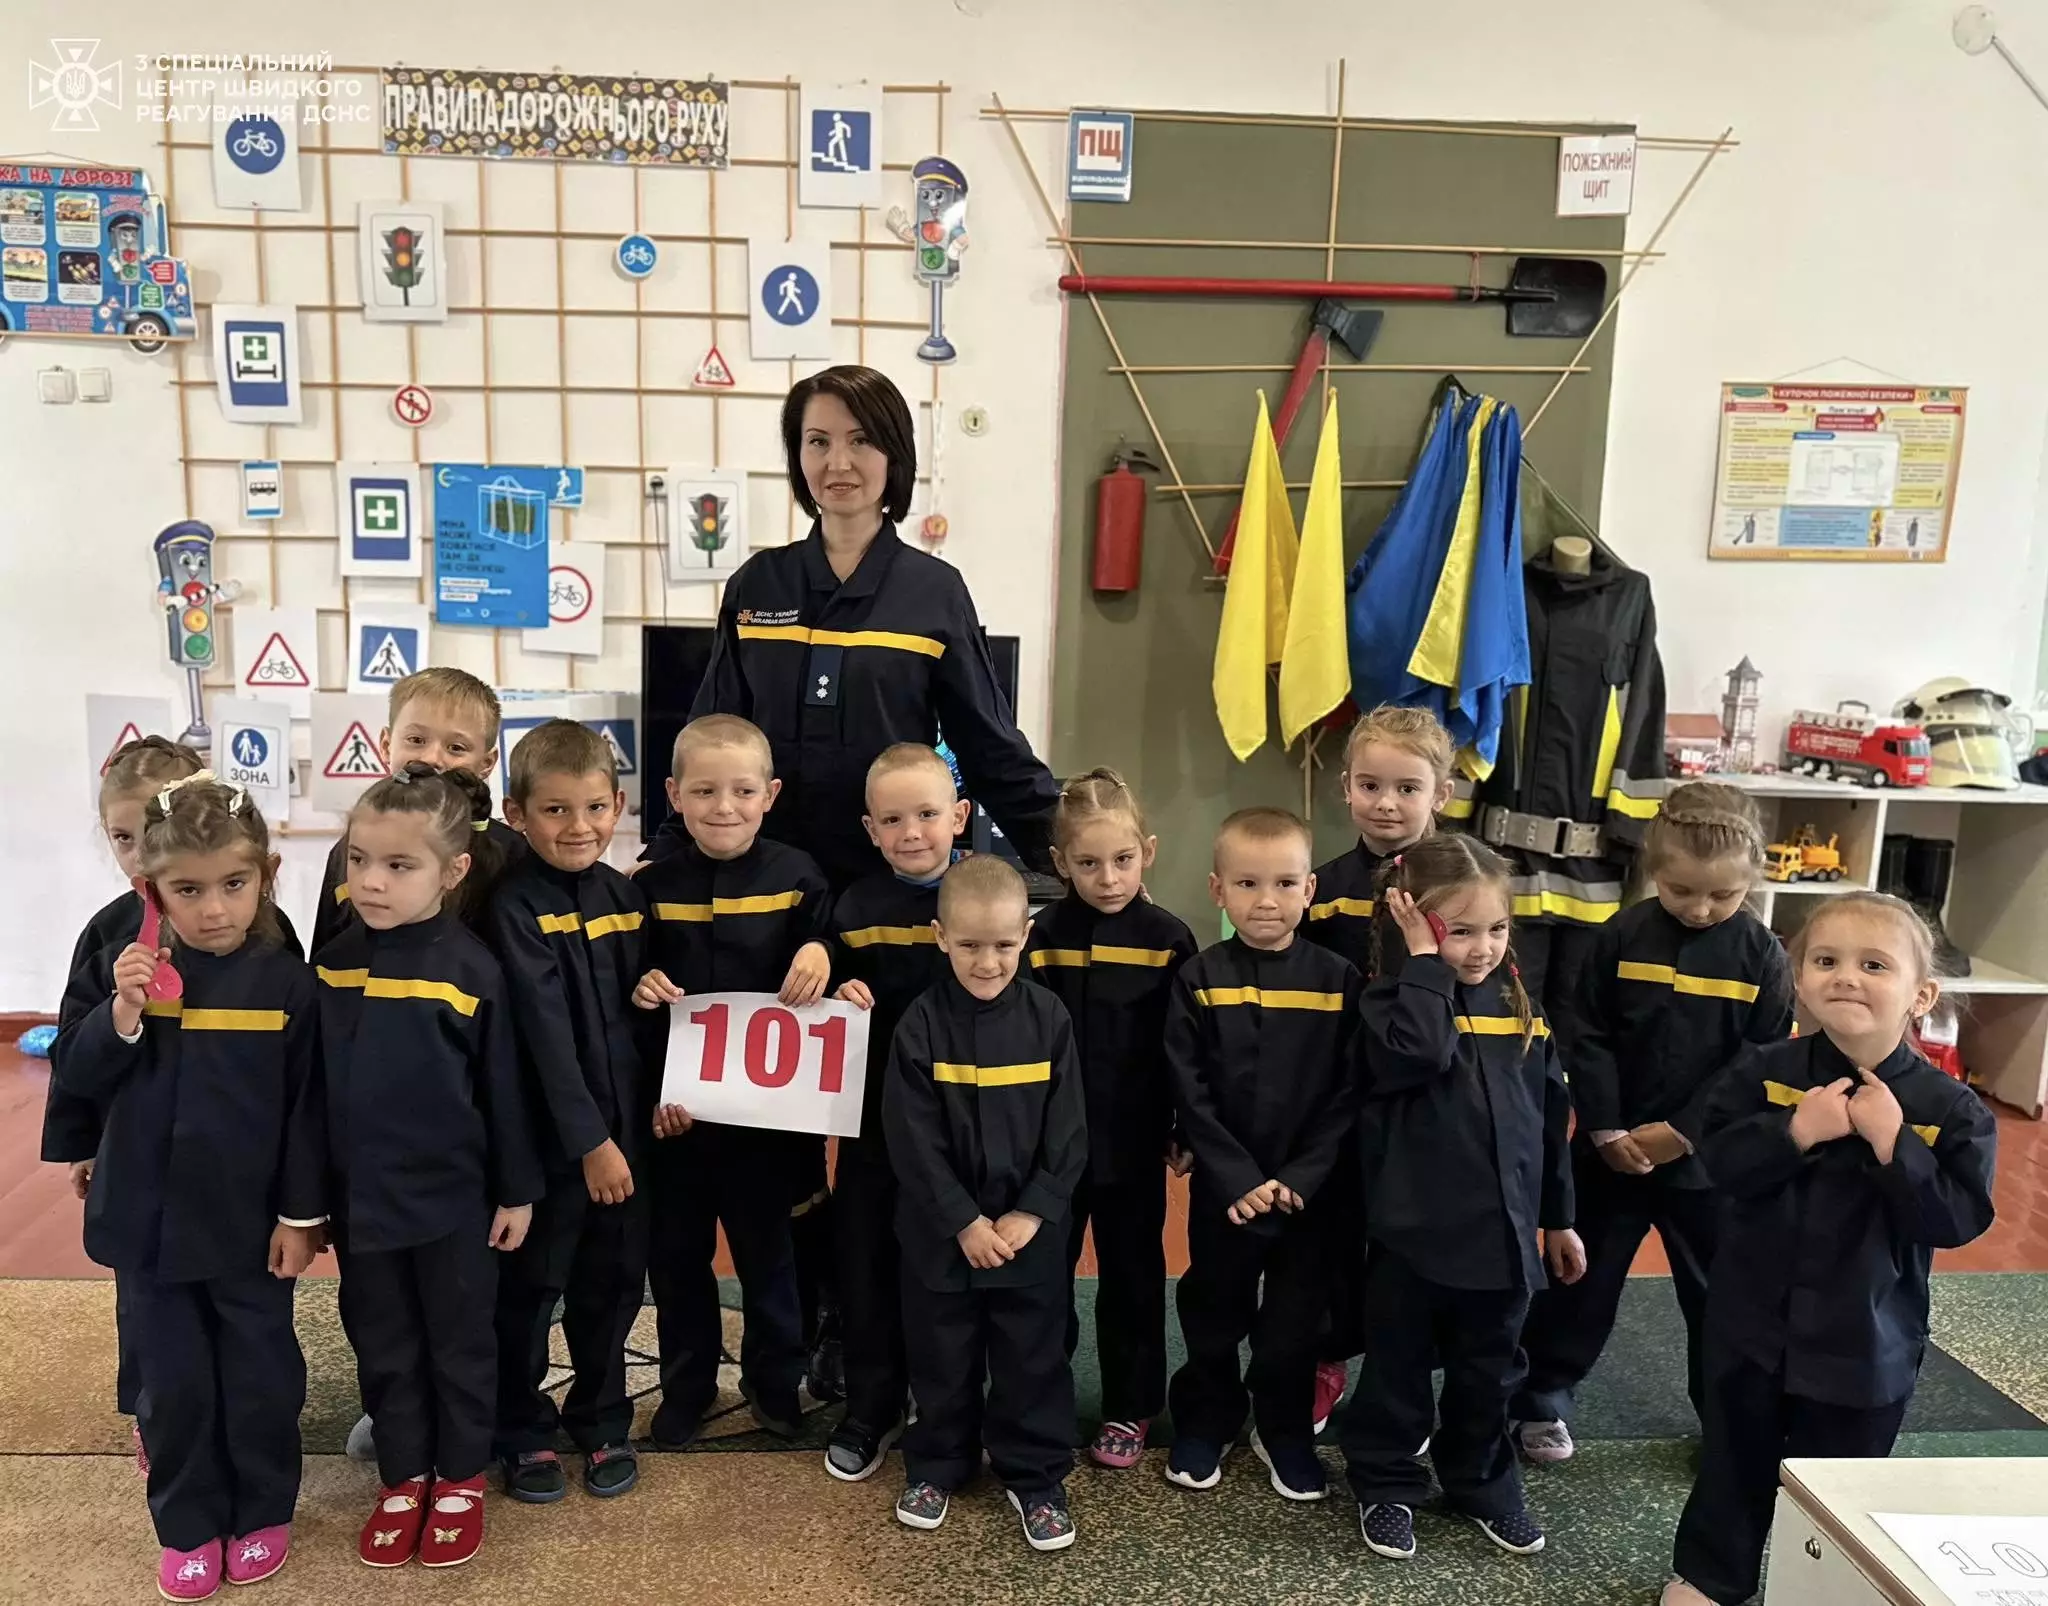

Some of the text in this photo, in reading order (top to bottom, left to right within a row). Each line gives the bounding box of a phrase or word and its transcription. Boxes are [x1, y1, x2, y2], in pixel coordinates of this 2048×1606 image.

[385, 84, 728, 146] ПРАВИЛА ДОРОЖНЬОГО РУХУ
[1079, 129, 1121, 163] ПЩ
[1563, 148, 1632, 172] ПОЖЕЖНИЙ
[29, 167, 53, 183] НА
[60, 168, 133, 187] ДОРОЗІ
[1583, 179, 1611, 202] ЩИТ
[231, 768, 270, 784] ЗОНА
[690, 1003, 847, 1093] 101
